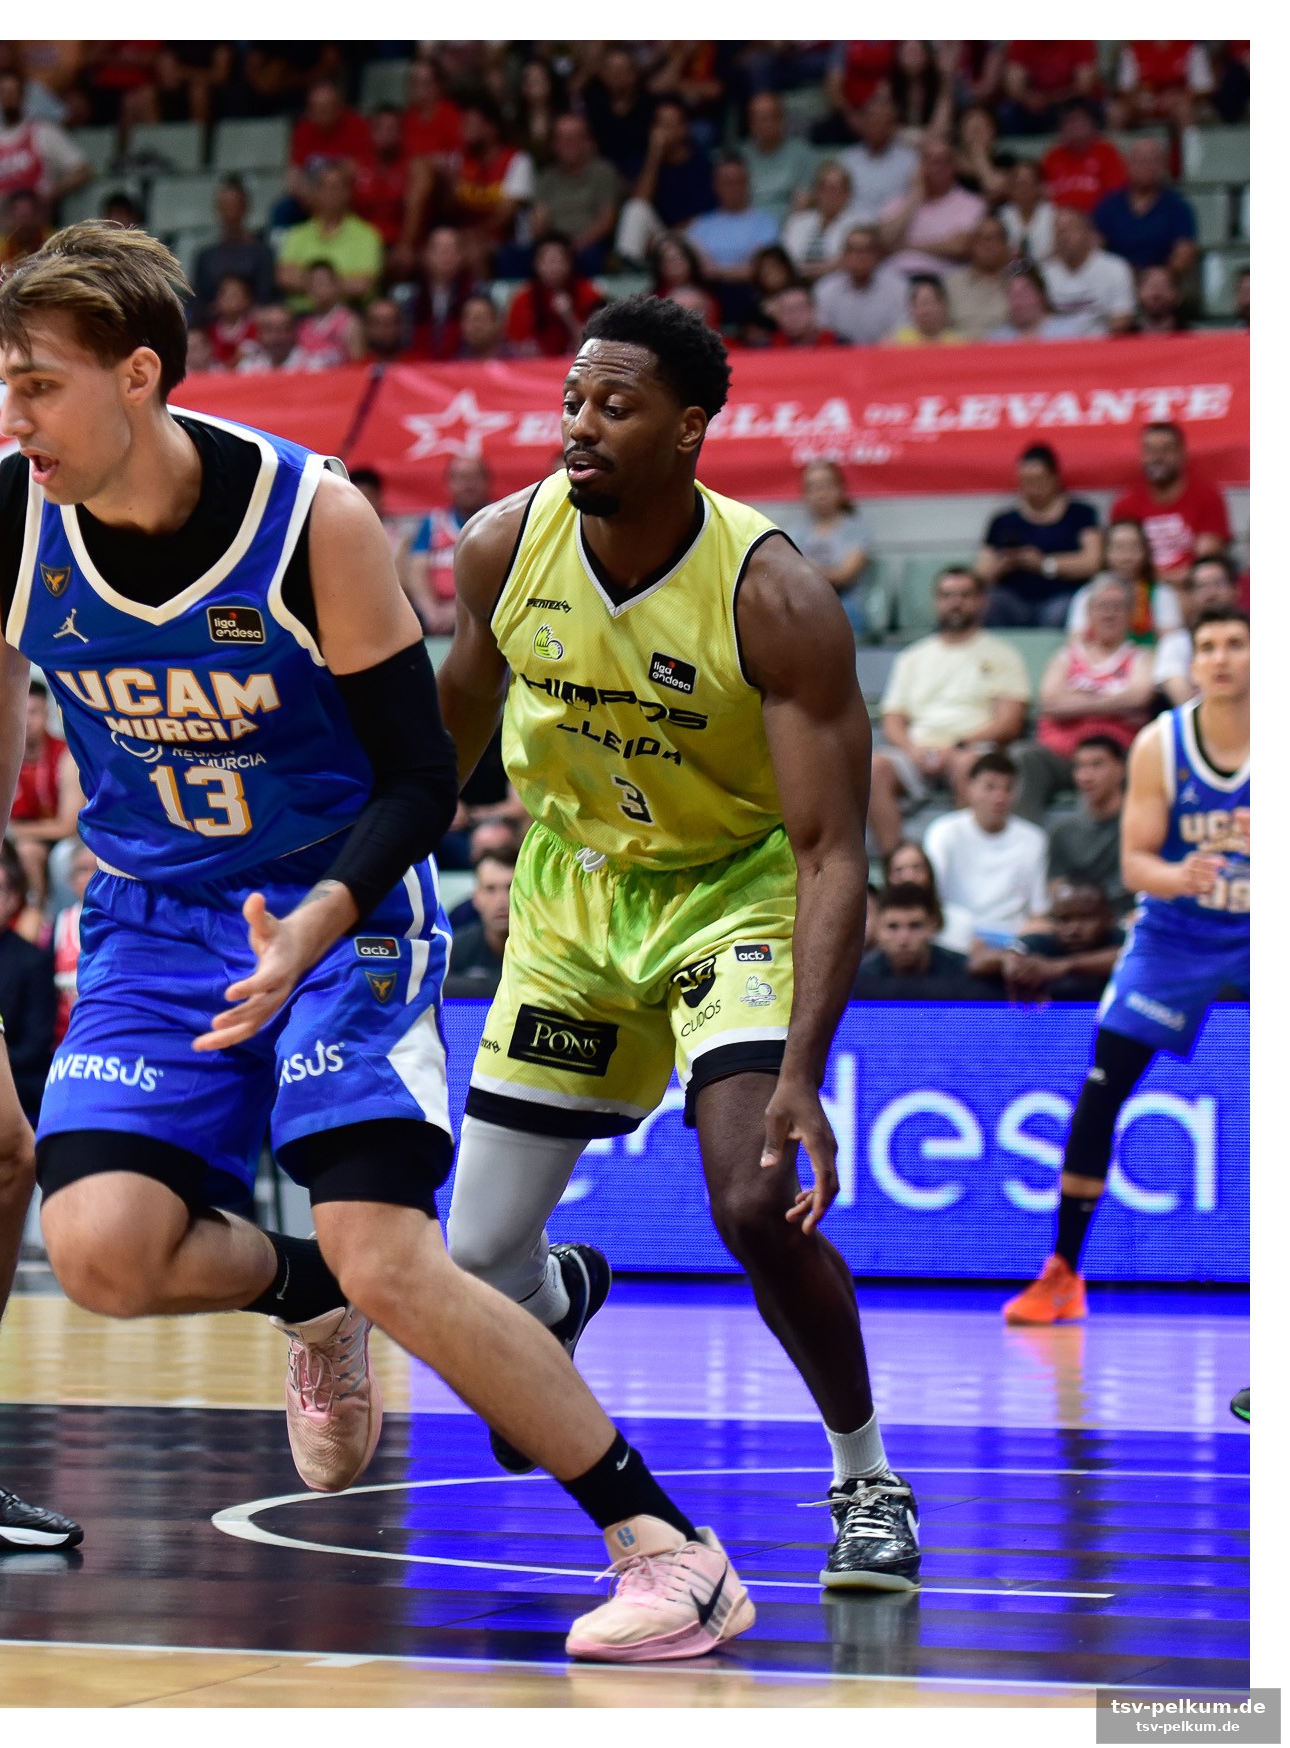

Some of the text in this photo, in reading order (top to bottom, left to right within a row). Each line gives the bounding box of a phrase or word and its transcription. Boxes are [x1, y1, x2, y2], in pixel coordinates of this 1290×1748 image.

[912, 383, 1233, 432] LEVANTE
[214, 617, 237, 629] liga
[215, 628, 262, 639] endesa
[652, 671, 691, 692] endesa
[653, 661, 672, 675] liga
[55, 668, 282, 720] UCAM
[106, 715, 260, 744] MURCIA
[148, 765, 254, 838] 13
[611, 774, 656, 826] 3
[360, 943, 390, 956] acb
[738, 950, 765, 961] acb
[681, 999, 722, 1037] CUDÓS
[530, 1021, 601, 1059] PONS
